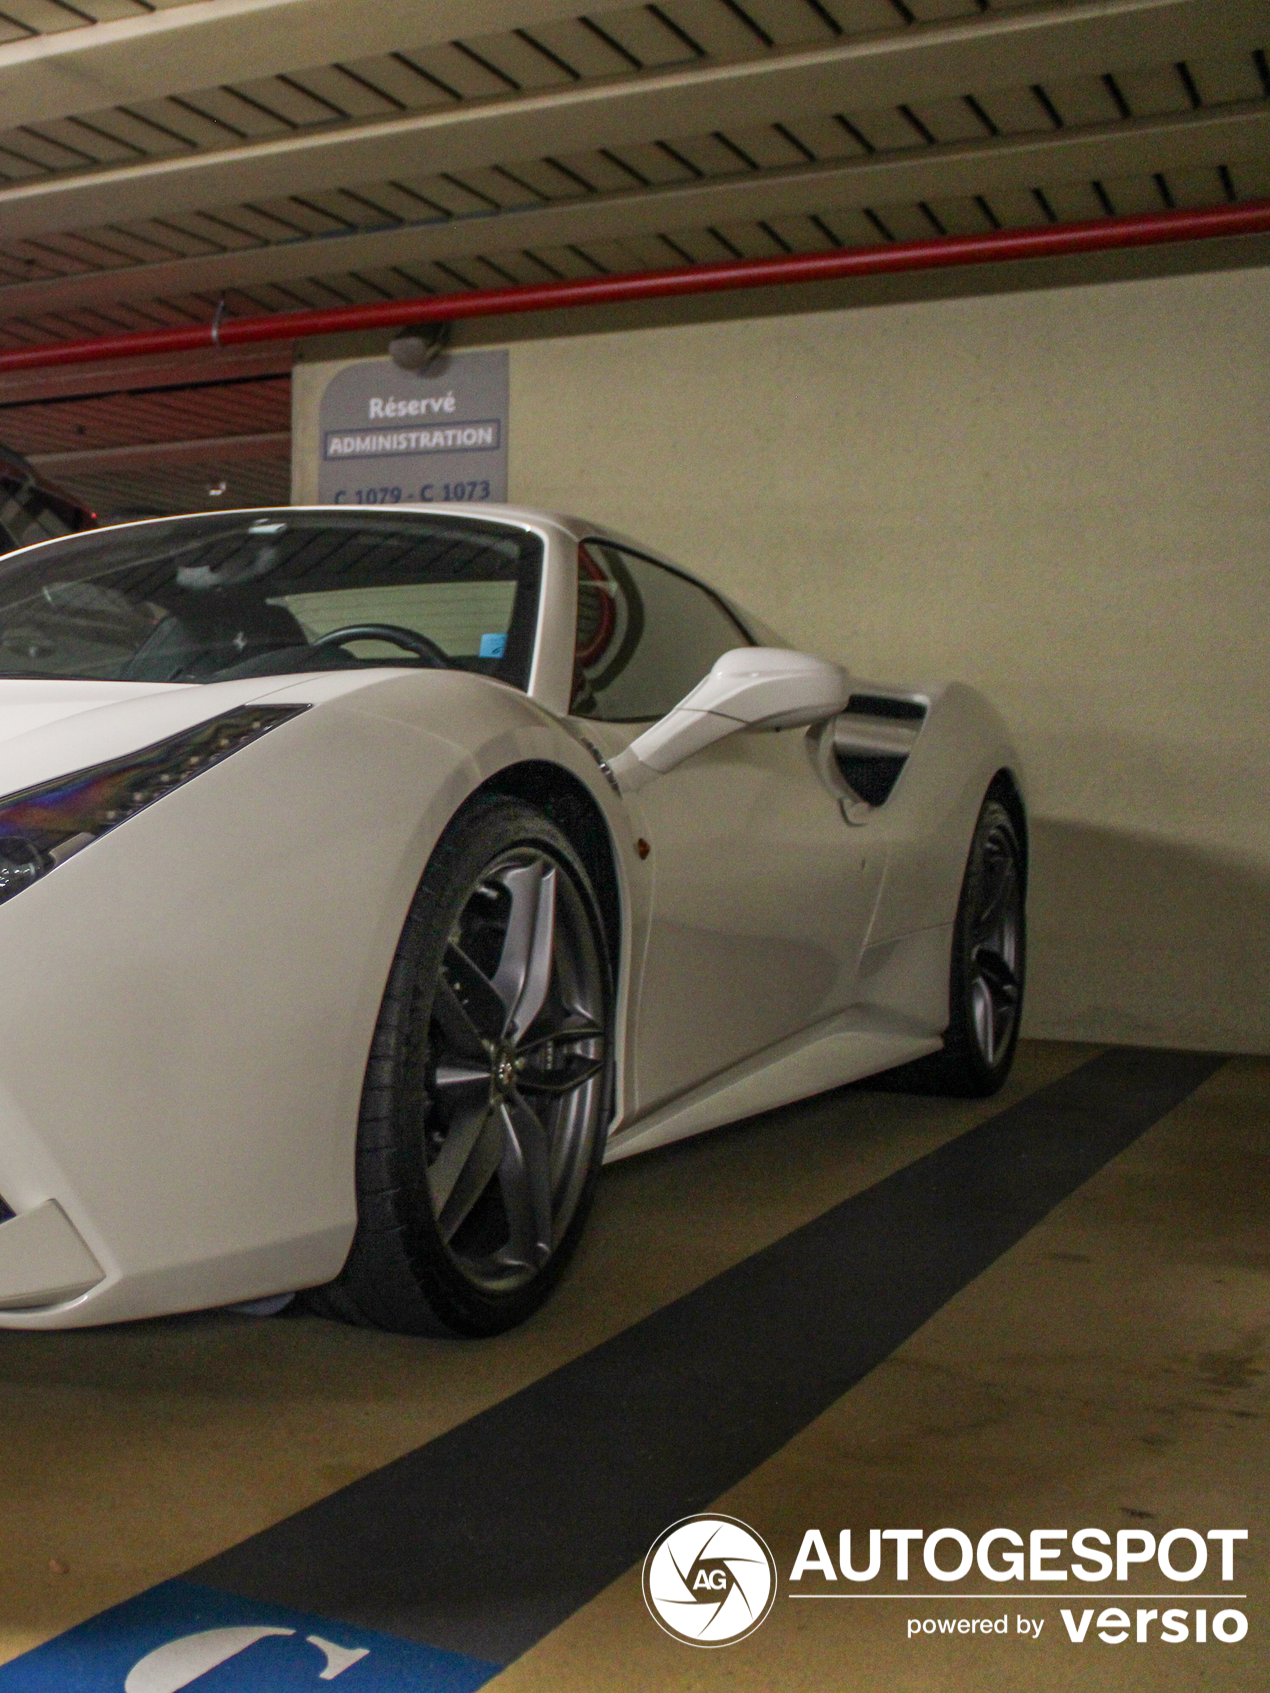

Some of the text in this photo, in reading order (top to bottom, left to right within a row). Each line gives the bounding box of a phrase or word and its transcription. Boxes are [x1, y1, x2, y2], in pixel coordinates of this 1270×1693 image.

[369, 391, 456, 419] Réservé
[329, 427, 493, 454] ADMINISTRATION
[334, 490, 347, 504] C
[355, 487, 402, 504] 1079
[420, 484, 434, 502] C
[443, 480, 491, 502] 1073
